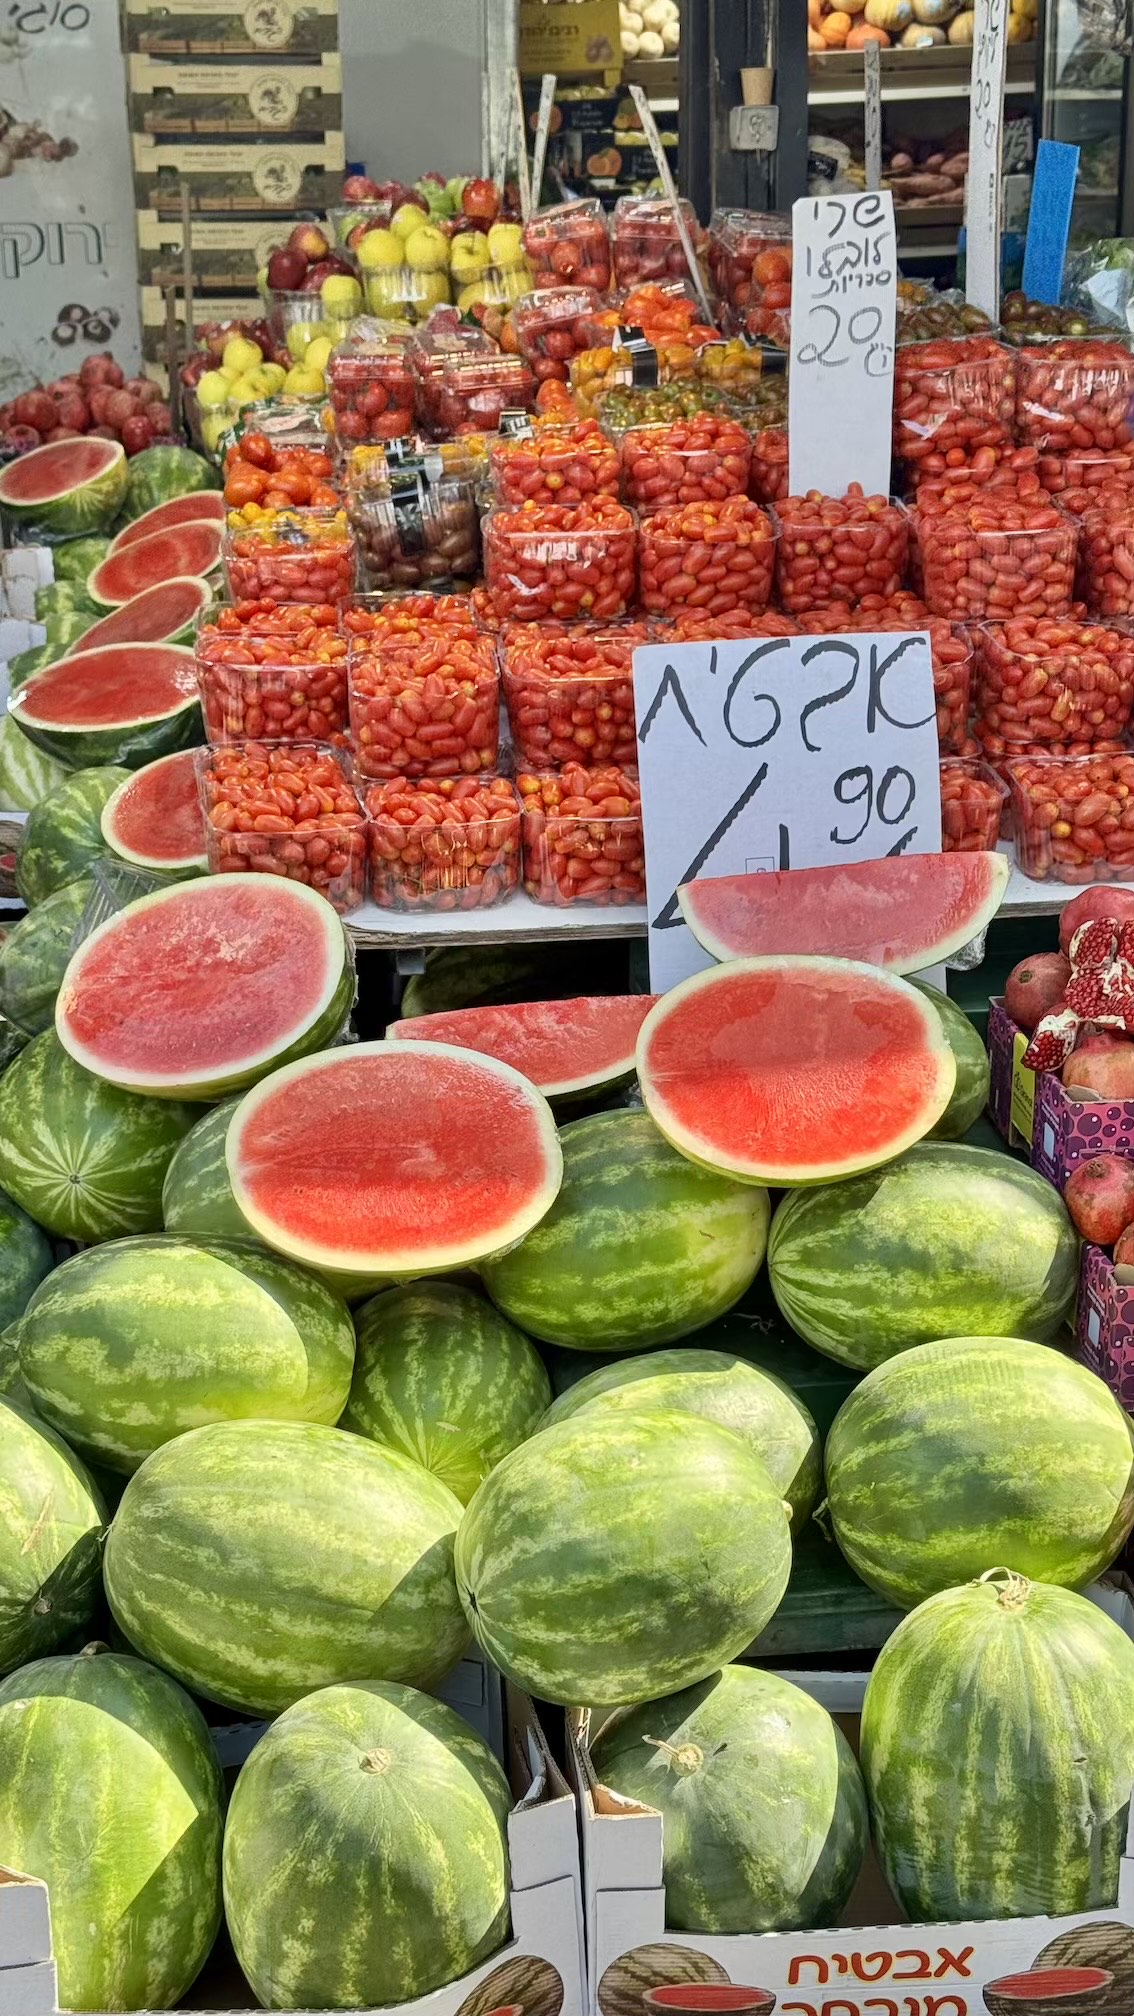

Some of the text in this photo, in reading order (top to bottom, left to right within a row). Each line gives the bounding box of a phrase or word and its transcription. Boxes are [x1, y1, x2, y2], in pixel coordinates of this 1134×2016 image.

[813, 194, 885, 239] שרי
[797, 304, 883, 367] 20
[638, 637, 936, 752] אבטיח
[830, 765, 916, 844] 90
[788, 1946, 975, 1985] אבטיח
